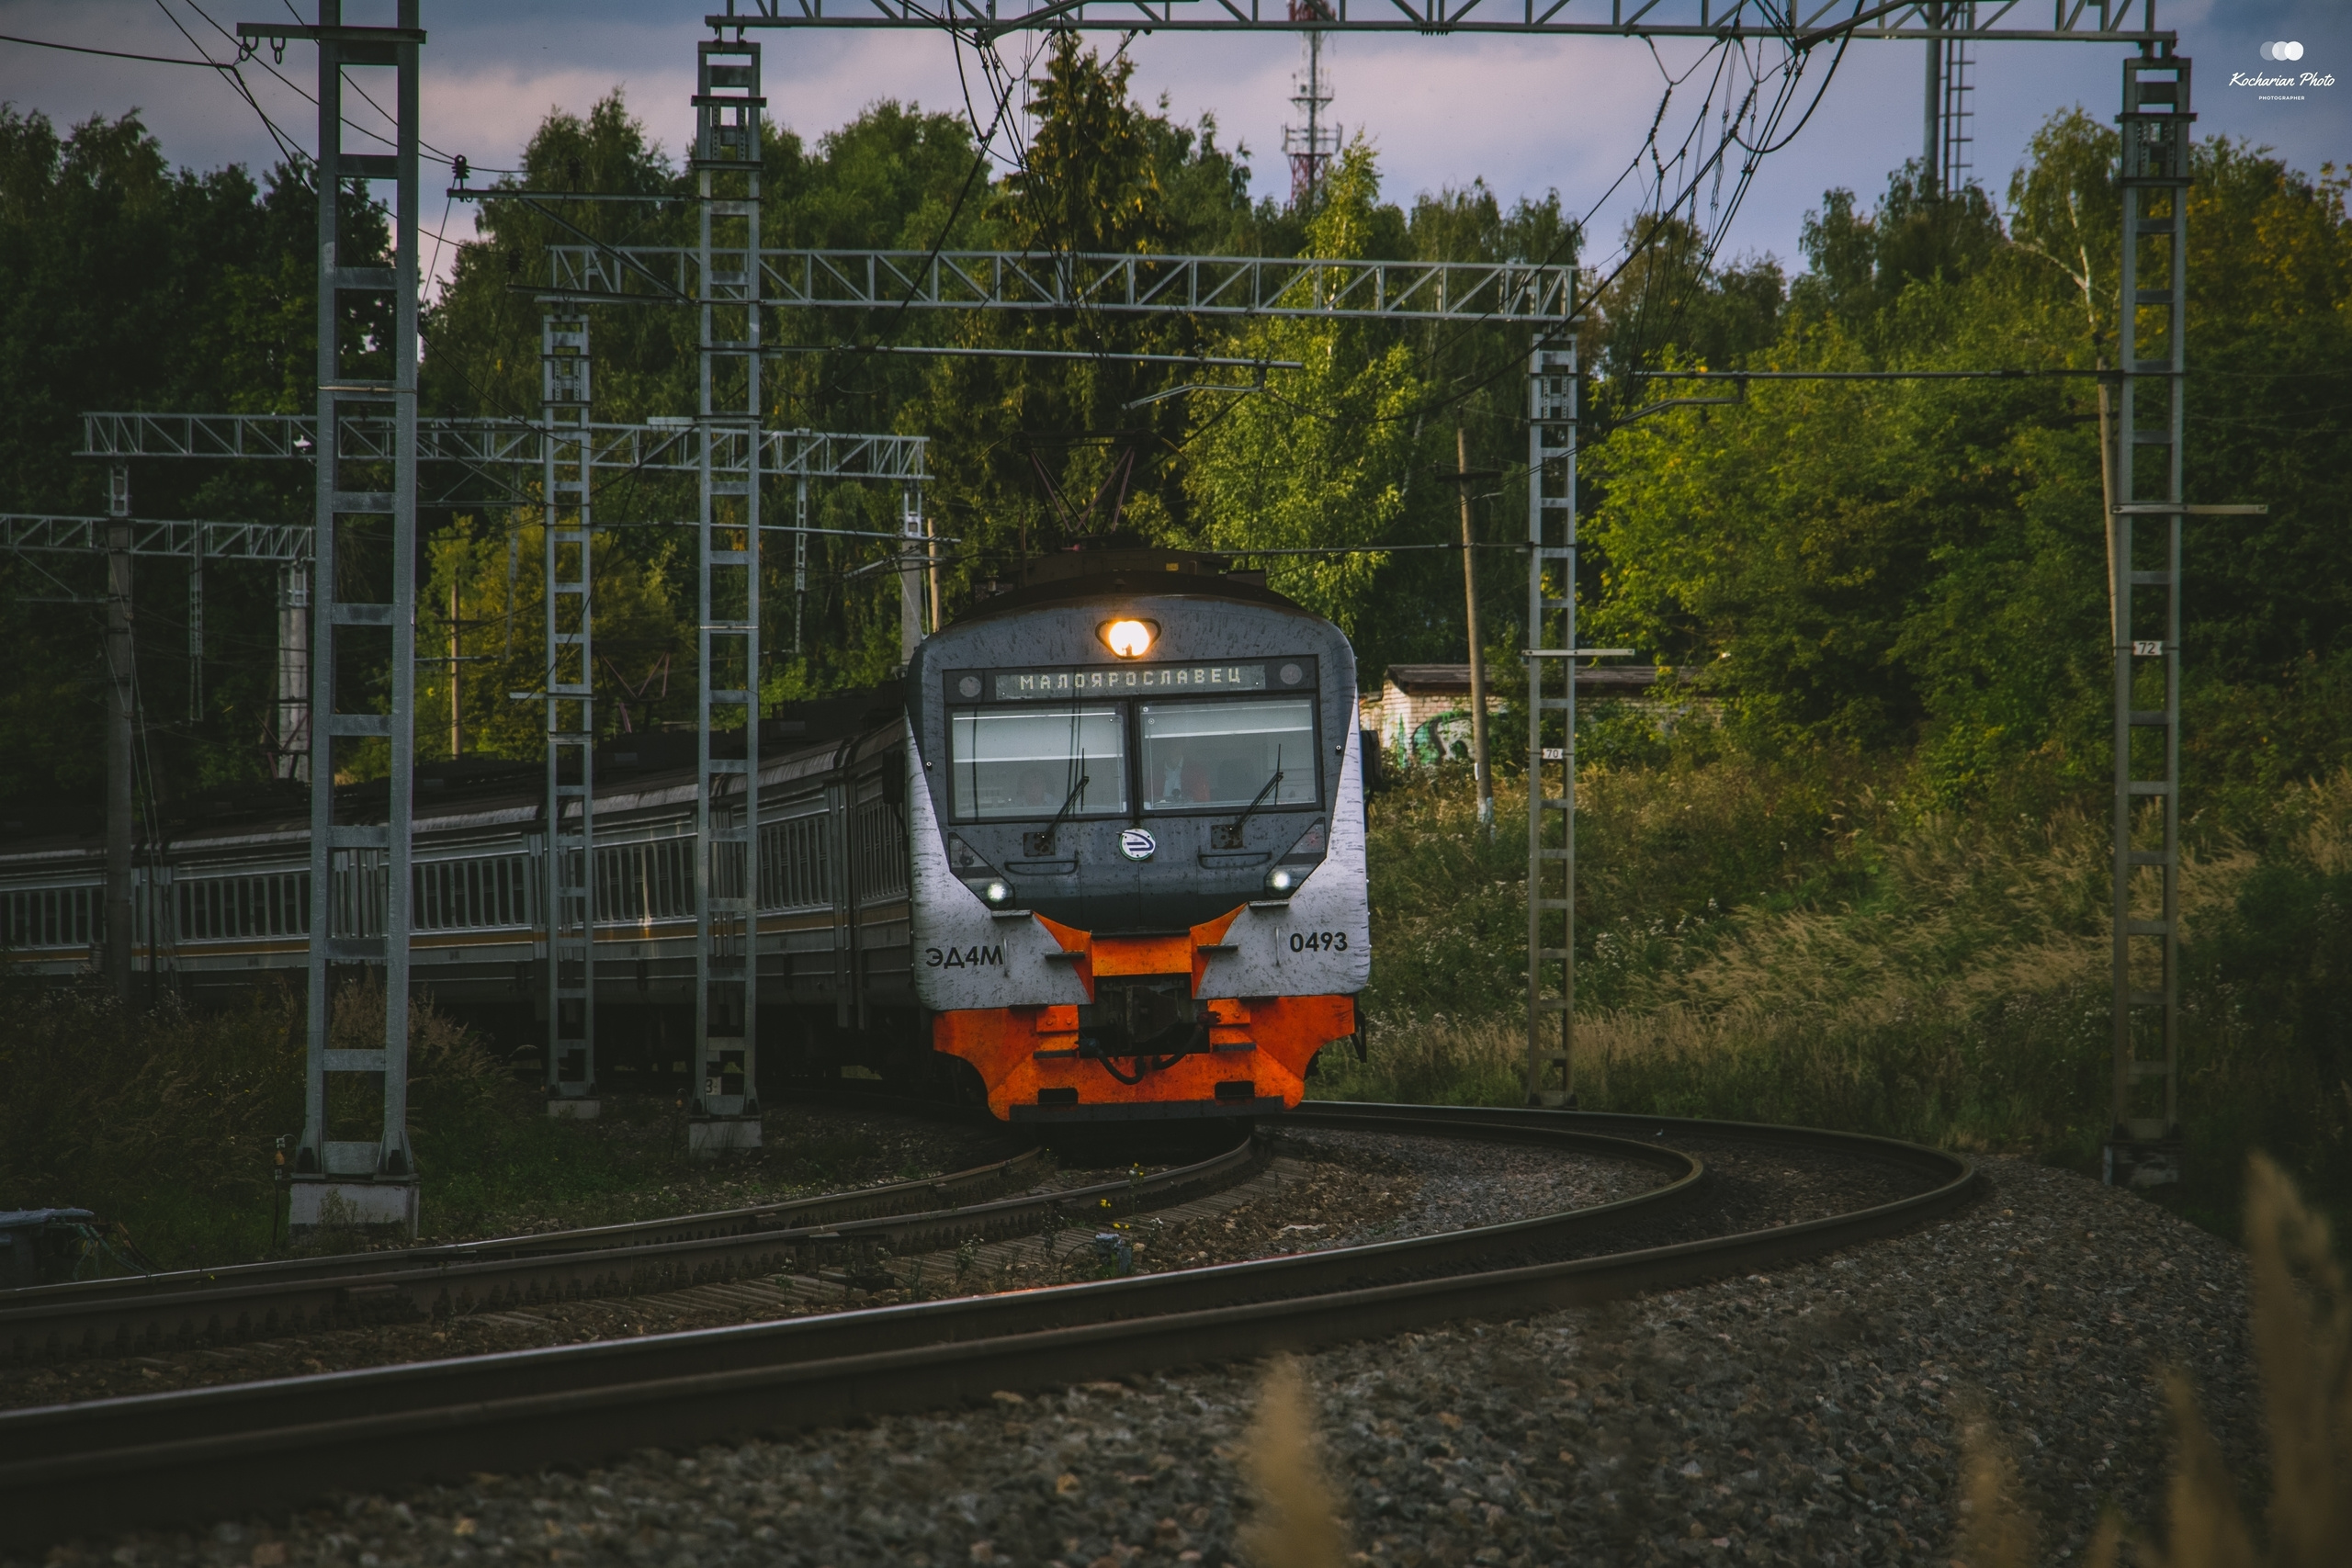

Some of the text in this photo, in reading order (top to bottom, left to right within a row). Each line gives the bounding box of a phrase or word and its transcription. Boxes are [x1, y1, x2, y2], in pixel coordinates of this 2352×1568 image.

[2139, 642, 2155, 654] 72
[1019, 667, 1241, 691] МАЛОЯРОСЛАВЕЦ
[1546, 749, 1559, 759] 70
[1290, 931, 1348, 953] 0493
[925, 945, 1004, 970] ЭД4М
